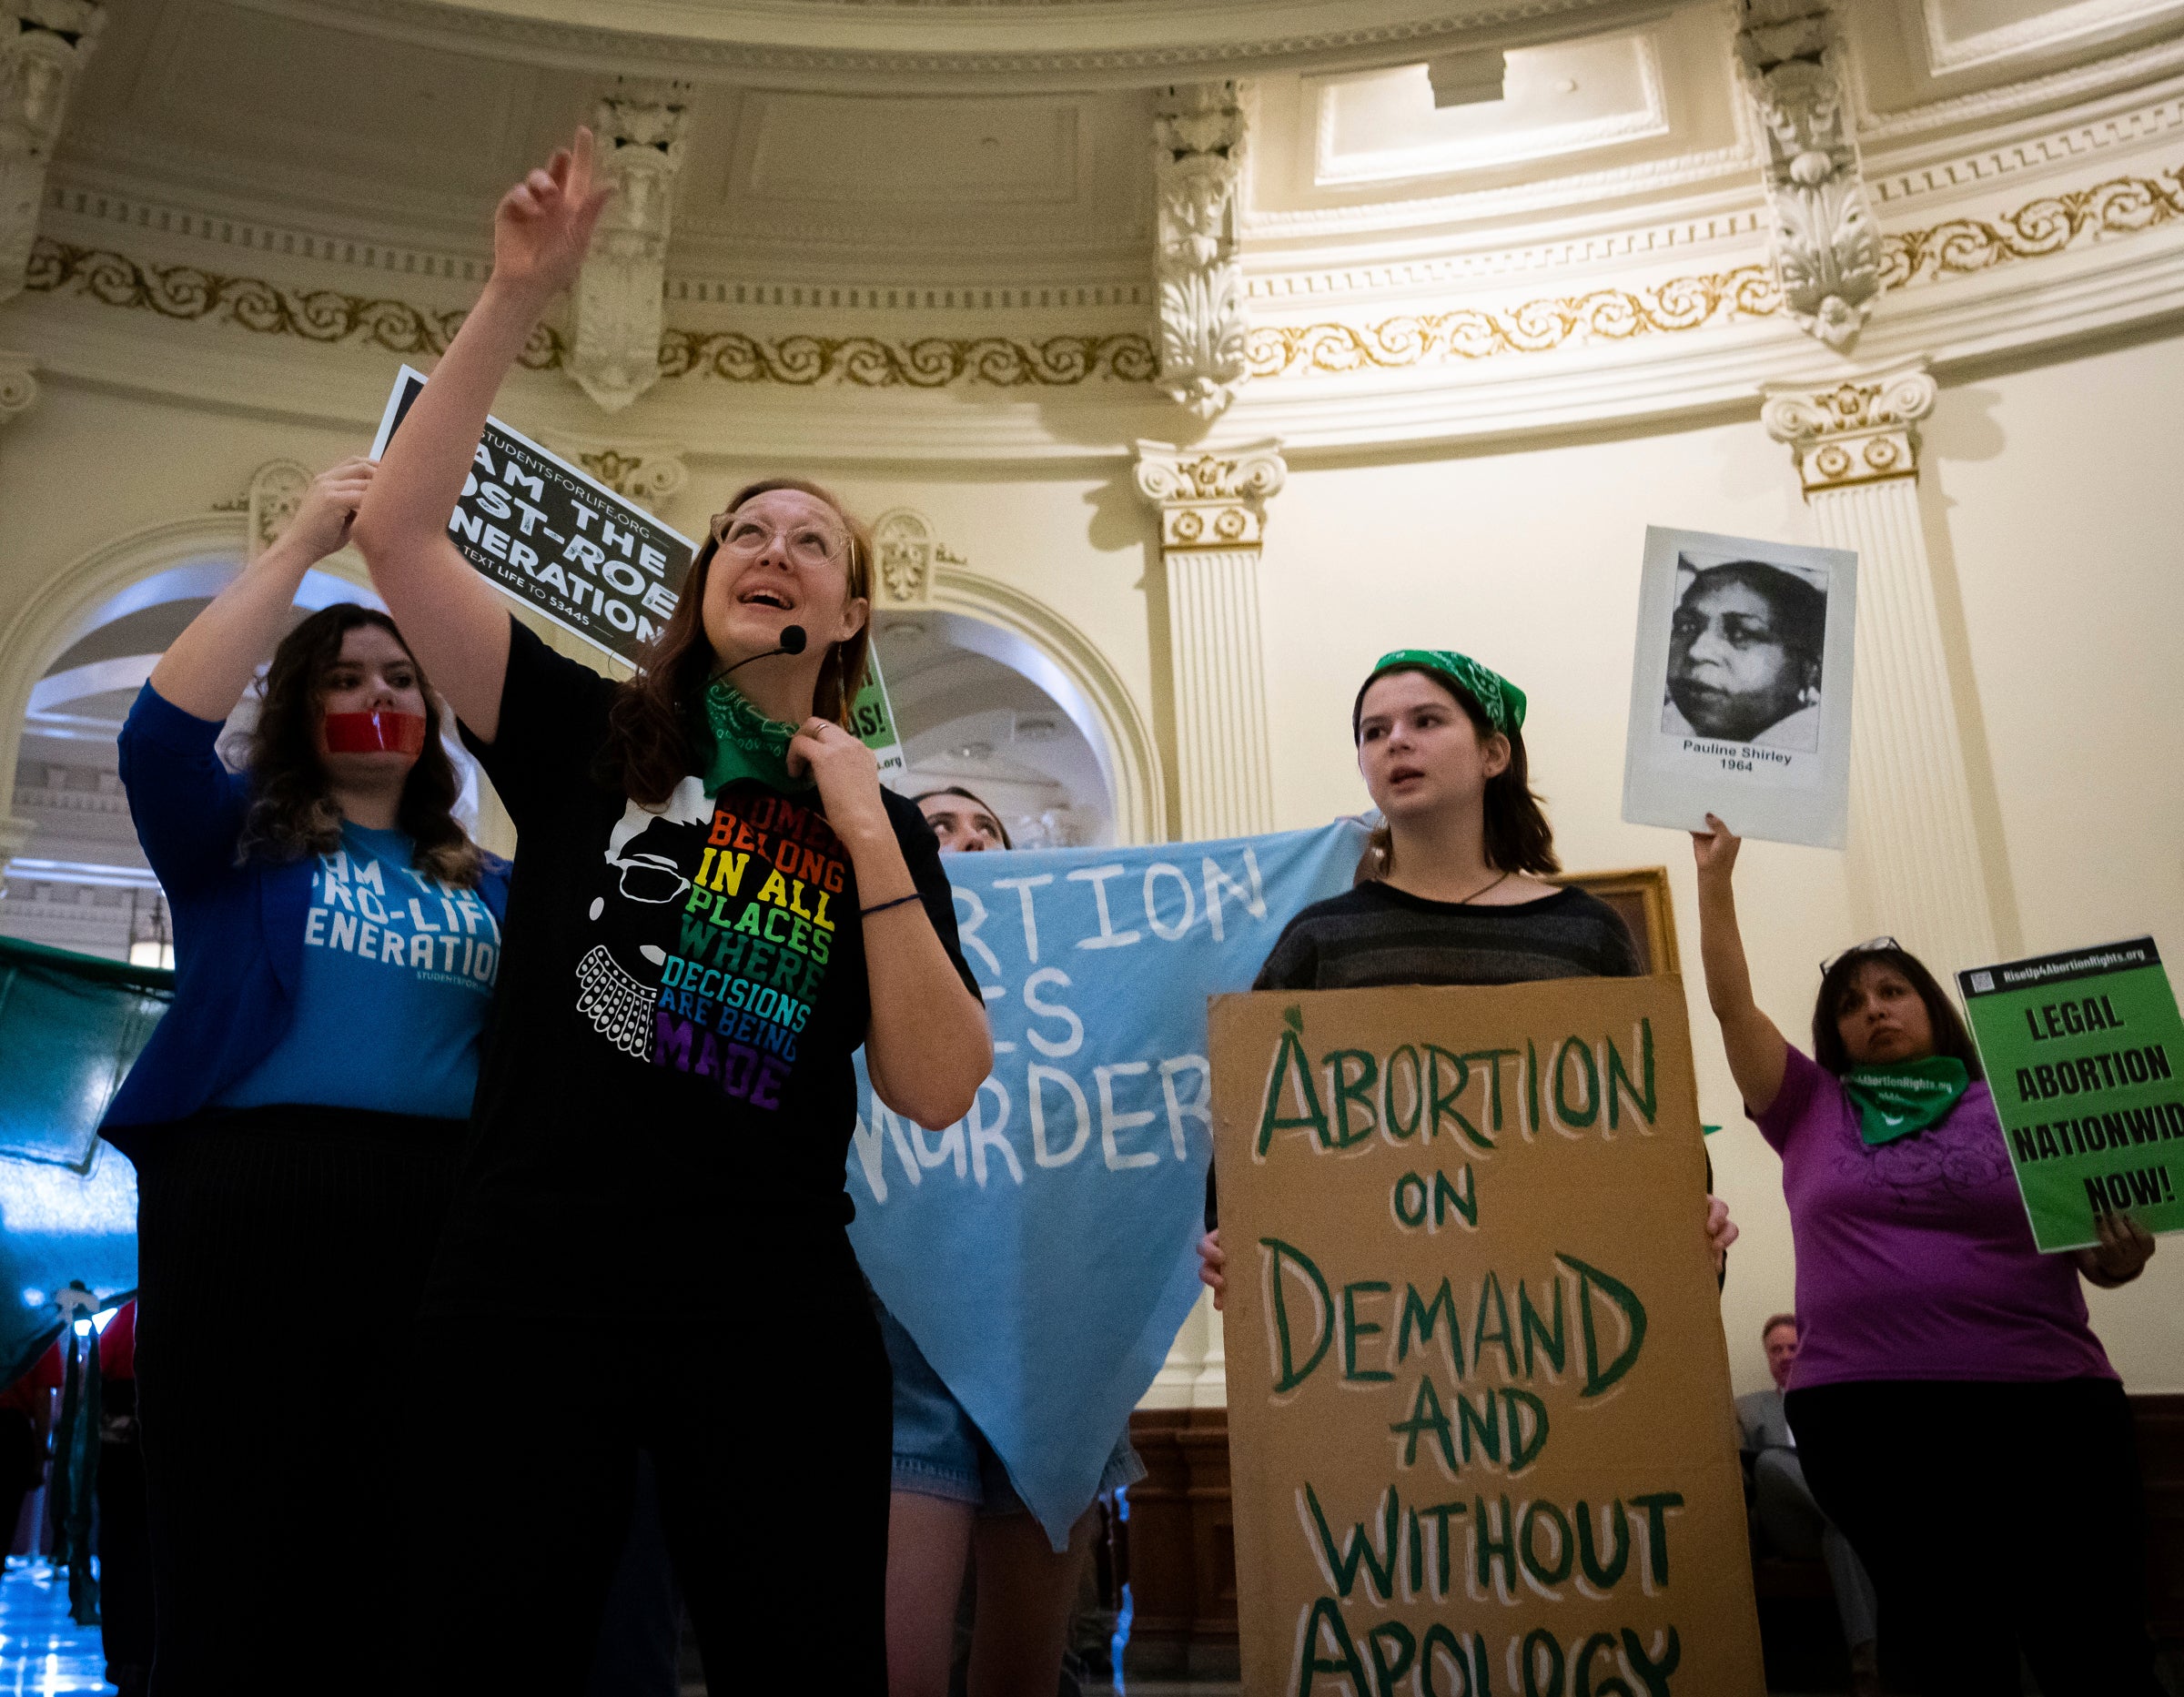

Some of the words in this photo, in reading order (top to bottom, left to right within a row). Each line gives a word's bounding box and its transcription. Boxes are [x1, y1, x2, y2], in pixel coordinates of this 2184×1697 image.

[448, 505, 667, 647] NERATION
[571, 499, 667, 579] THE
[463, 546, 494, 570] TEXT
[497, 566, 525, 589] LIFE
[528, 582, 546, 601] TO
[550, 596, 591, 626] 53445
[1684, 739, 1737, 757] Pauline
[1741, 746, 1793, 766] Shirley
[1720, 758, 1754, 773] 1964
[693, 847, 750, 897] IN
[757, 867, 835, 932] ALL
[708, 810, 845, 894] BELONG
[304, 906, 500, 987] ENERATIO
[312, 872, 501, 946] RO-LIF
[685, 884, 833, 965] PLACES
[951, 844, 1268, 976] RTION
[661, 955, 812, 1034] DECISIONS
[679, 913, 825, 1005] WHERE
[2003, 948, 2146, 984] RiseUp4AbortionRights.org
[658, 986, 712, 1027] ARE
[716, 1005, 797, 1063] BEING
[2025, 995, 2125, 1041] LEGAL
[653, 1010, 793, 1111] MADE
[1251, 1015, 1657, 1164] ABORTION
[2016, 1045, 2174, 1103] ABORTION
[2011, 1101, 2184, 1164] NATIONWID
[1390, 1163, 1479, 1235] ON
[2083, 1166, 2177, 1214] NOW!
[1259, 1237, 1649, 1407] DEMAND
[1389, 1374, 1550, 1481] AND
[1294, 1480, 1684, 1609] WITHOUT
[1287, 1596, 1683, 1697] APOLOGY
